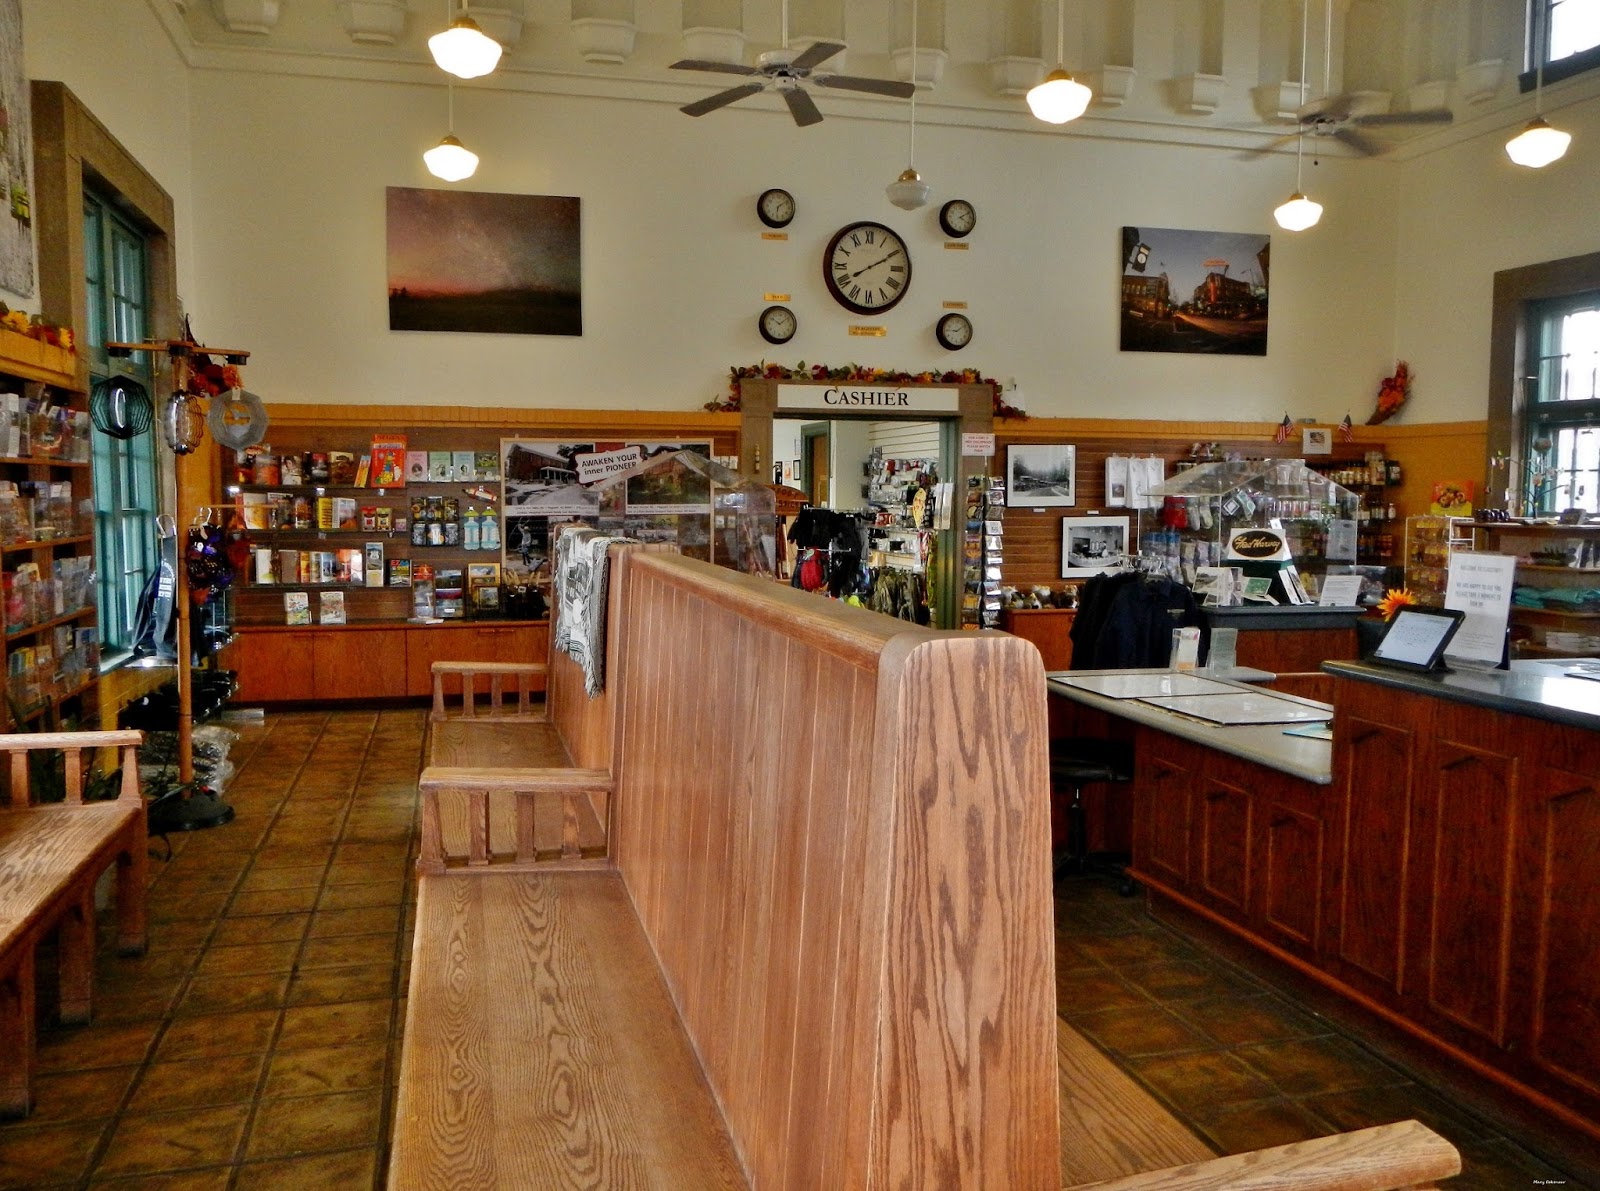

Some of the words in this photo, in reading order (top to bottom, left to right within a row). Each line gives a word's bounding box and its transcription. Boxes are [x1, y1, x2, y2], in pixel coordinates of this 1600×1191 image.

[850, 233, 861, 248] XI
[838, 245, 851, 257] X
[834, 262, 847, 270] IX
[879, 287, 888, 301] V
[824, 389, 908, 406] CASHIER
[582, 457, 614, 467] AWAKEN
[606, 462, 636, 472] PIONEER
